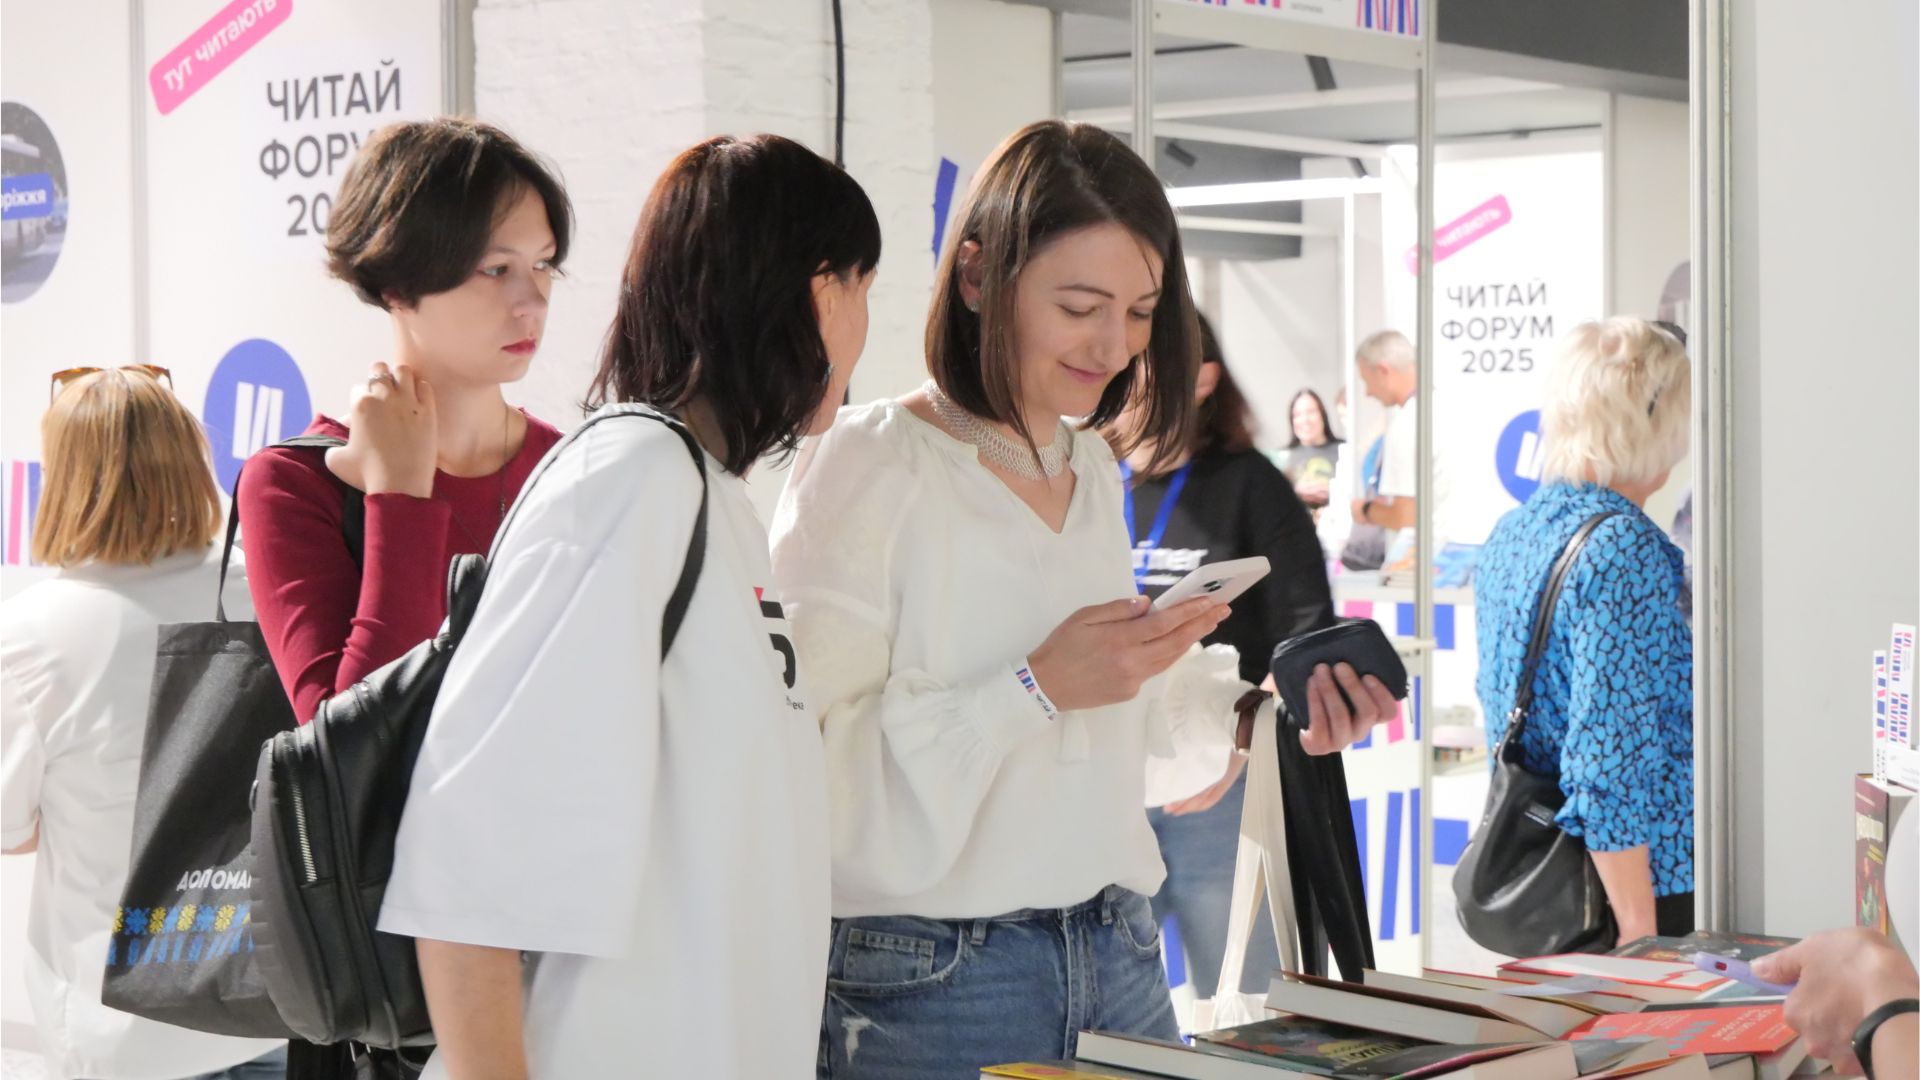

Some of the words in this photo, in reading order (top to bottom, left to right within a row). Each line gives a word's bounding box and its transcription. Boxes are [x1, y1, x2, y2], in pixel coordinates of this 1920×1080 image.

[163, 56, 192, 91] тут
[194, 0, 277, 62] читають
[267, 58, 401, 121] ЧИТАЙ
[259, 130, 375, 180] ФОР
[287, 192, 333, 236] 20
[1447, 277, 1547, 308] ЧИТАЙ
[1441, 315, 1554, 341] ФОРУМ
[1461, 349, 1534, 373] 2025
